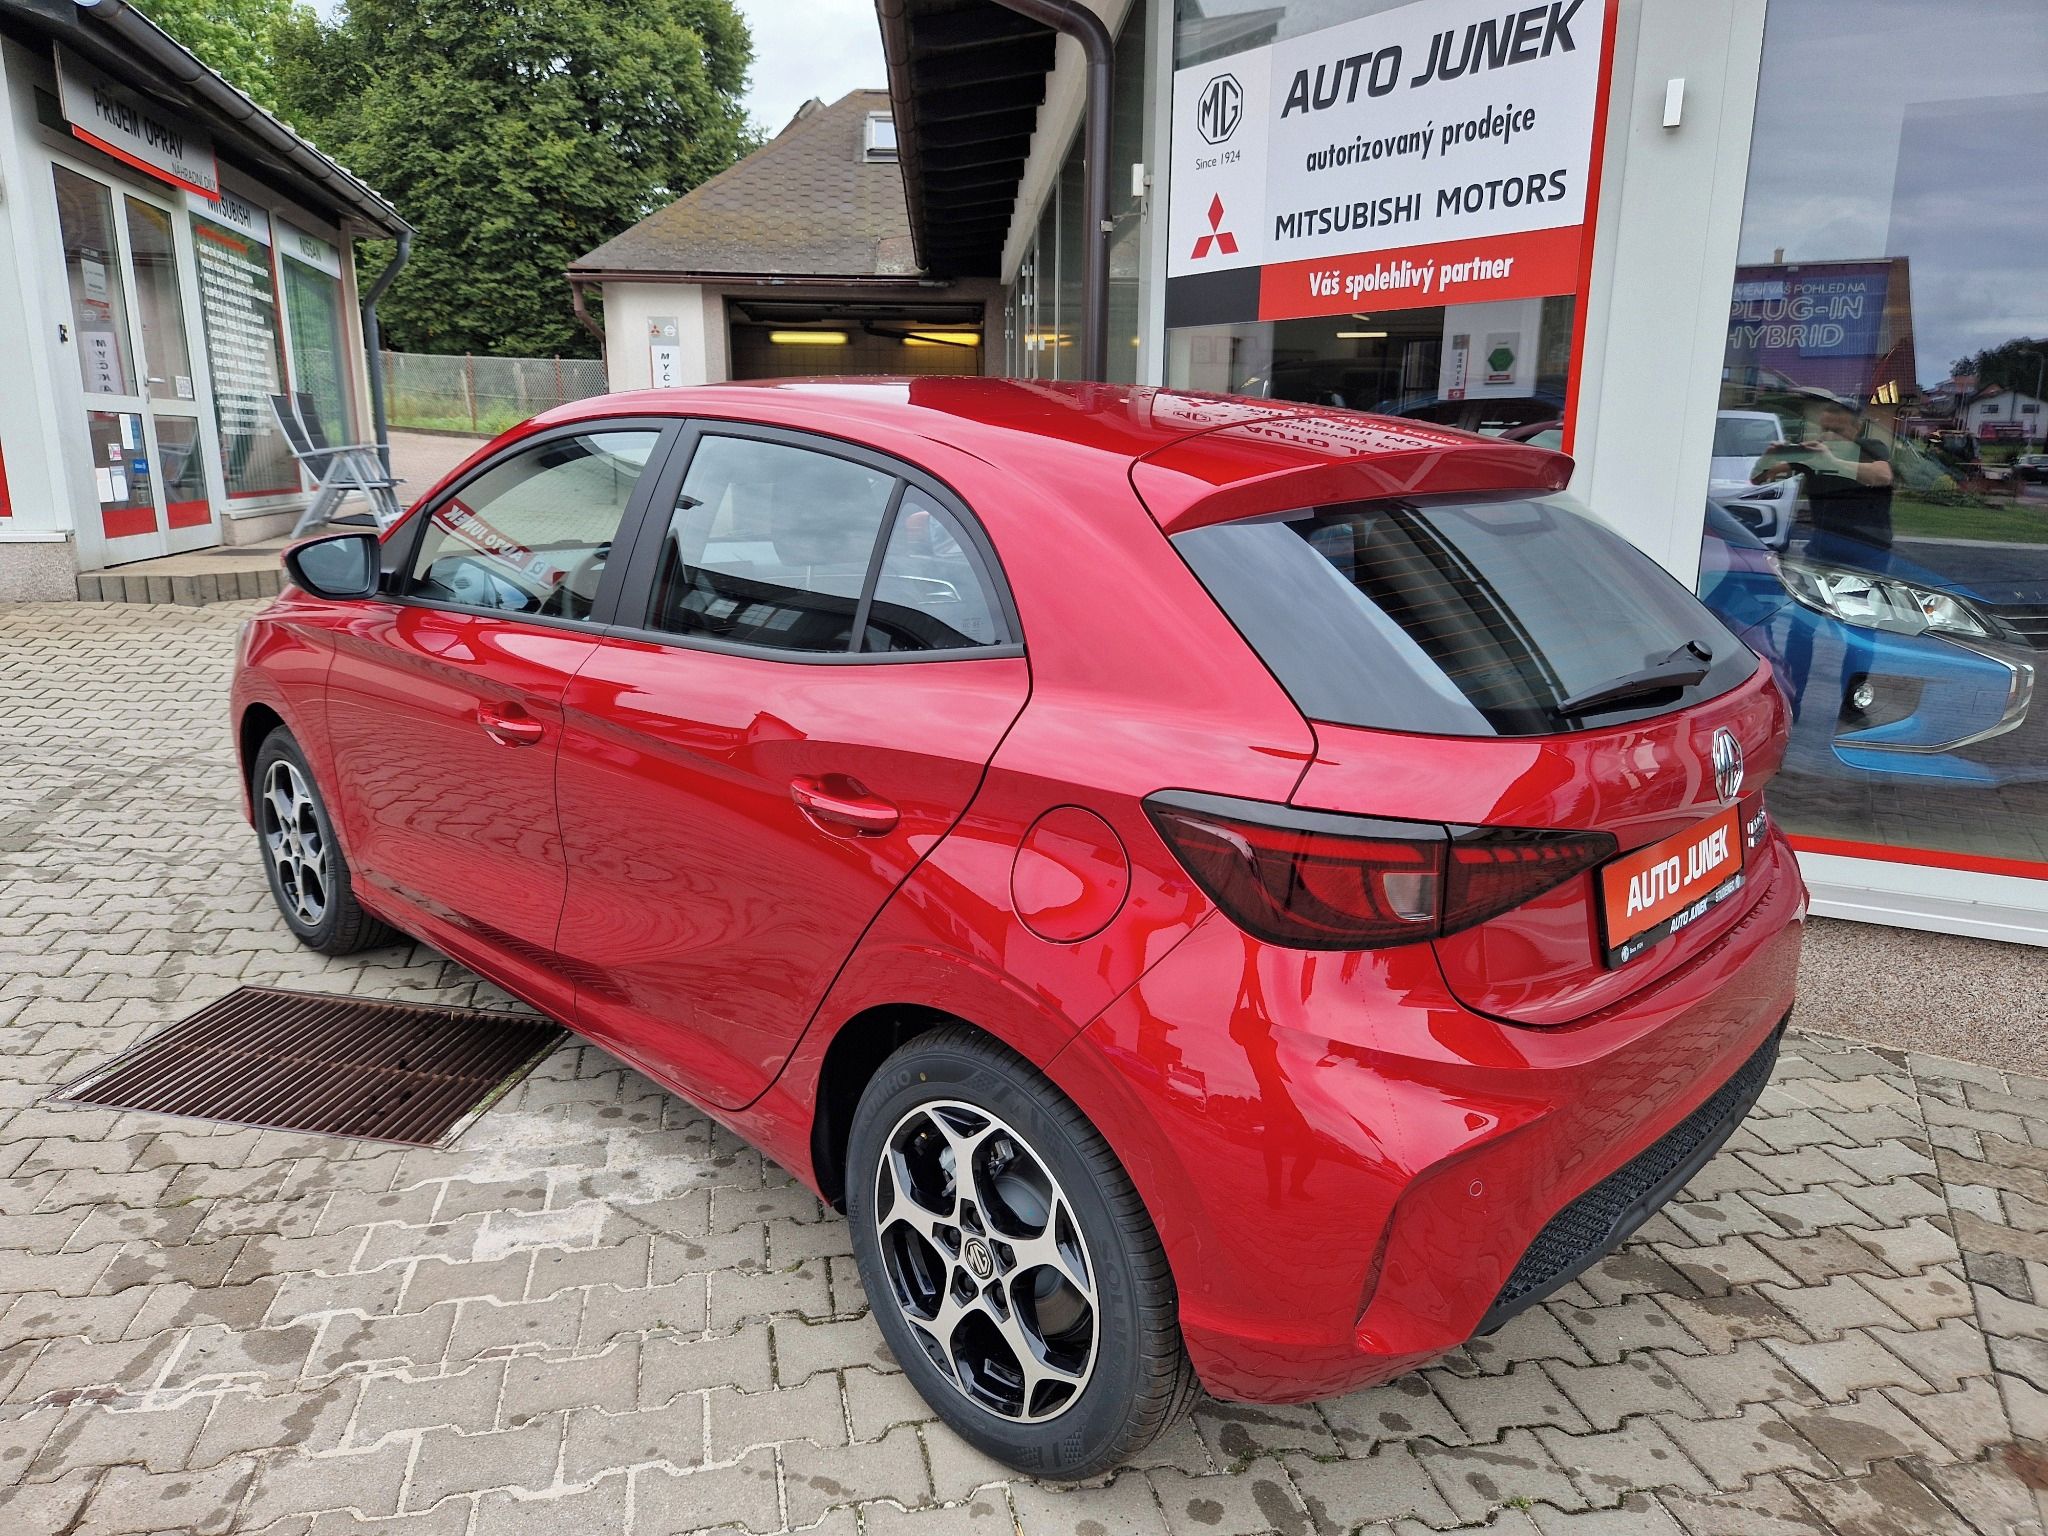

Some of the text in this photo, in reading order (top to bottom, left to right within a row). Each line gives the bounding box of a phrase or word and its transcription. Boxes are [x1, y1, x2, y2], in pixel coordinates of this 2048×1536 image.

[1280, 0, 1585, 119] AUTO JUNEK
[93, 84, 185, 161] PŘÍJEM OPRAV
[1200, 76, 1241, 142] MG
[1195, 149, 1241, 171] Since 1924
[1306, 103, 1537, 173] autorizovaný prodejce
[1274, 168, 1568, 242] MITSUBISHI MOTORS
[299, 236, 321, 262] NISSAN
[1309, 254, 1515, 301] Váš spolehlivý partner
[1793, 282, 1845, 295] POHLED
[1847, 281, 1866, 293] NA
[1731, 295, 1864, 322] PLUG-IN
[1625, 823, 1730, 918] AUTO JUNEK
[1669, 910, 1688, 934] AUTO
[1688, 897, 1709, 922] JUNEK
[966, 1242, 990, 1276] MG
